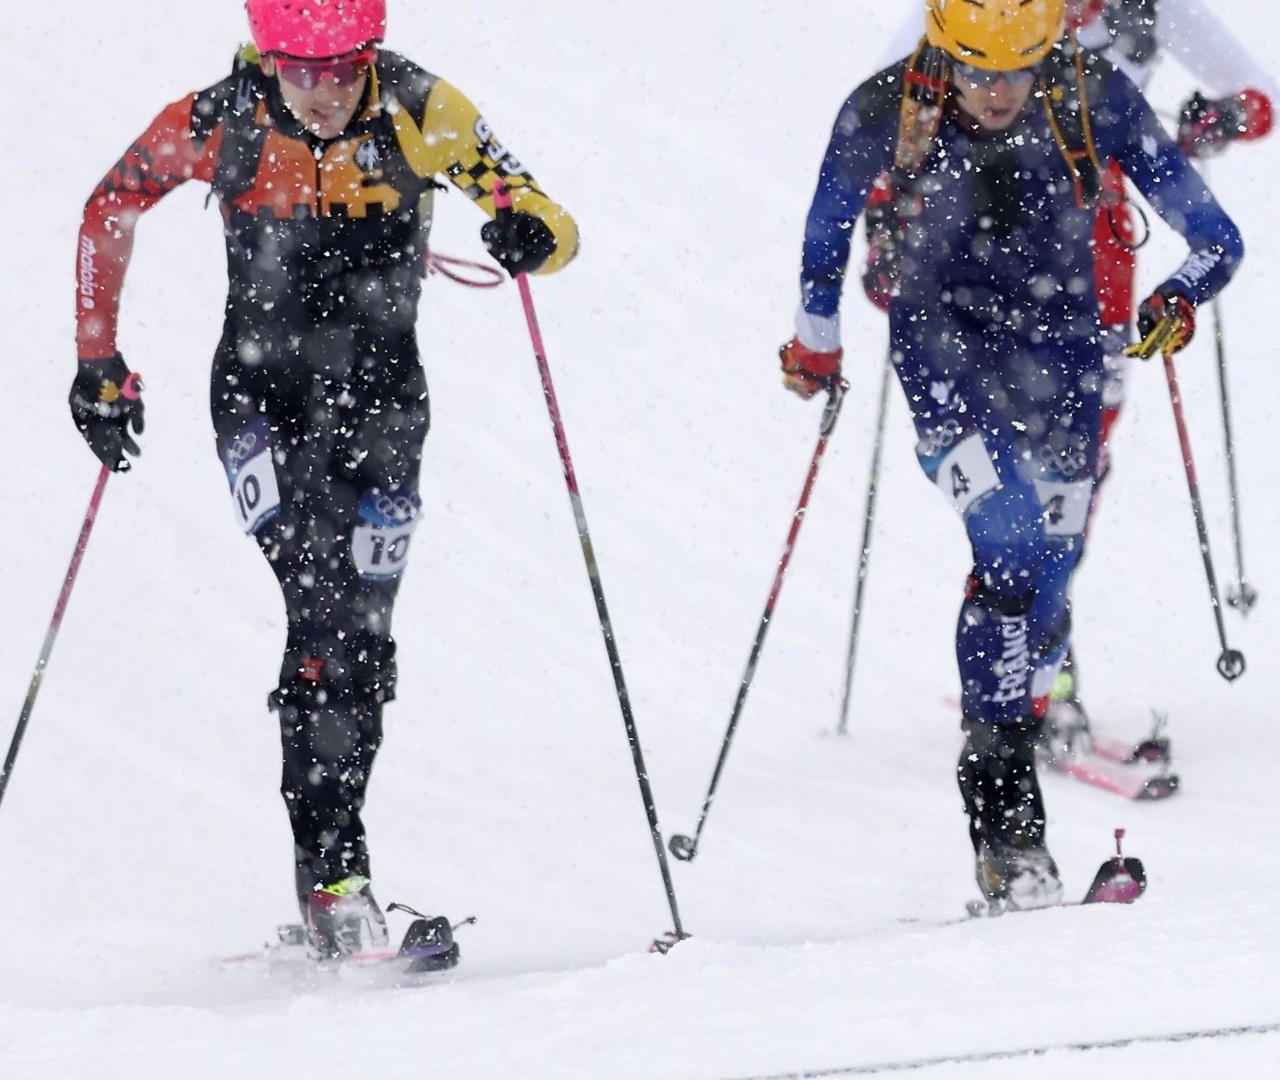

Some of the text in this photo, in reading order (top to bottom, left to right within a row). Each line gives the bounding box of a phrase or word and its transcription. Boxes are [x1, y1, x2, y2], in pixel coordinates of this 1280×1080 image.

[951, 462, 970, 499] 4
[236, 473, 261, 523] 10
[1045, 494, 1065, 526] 4
[370, 534, 411, 565] 10
